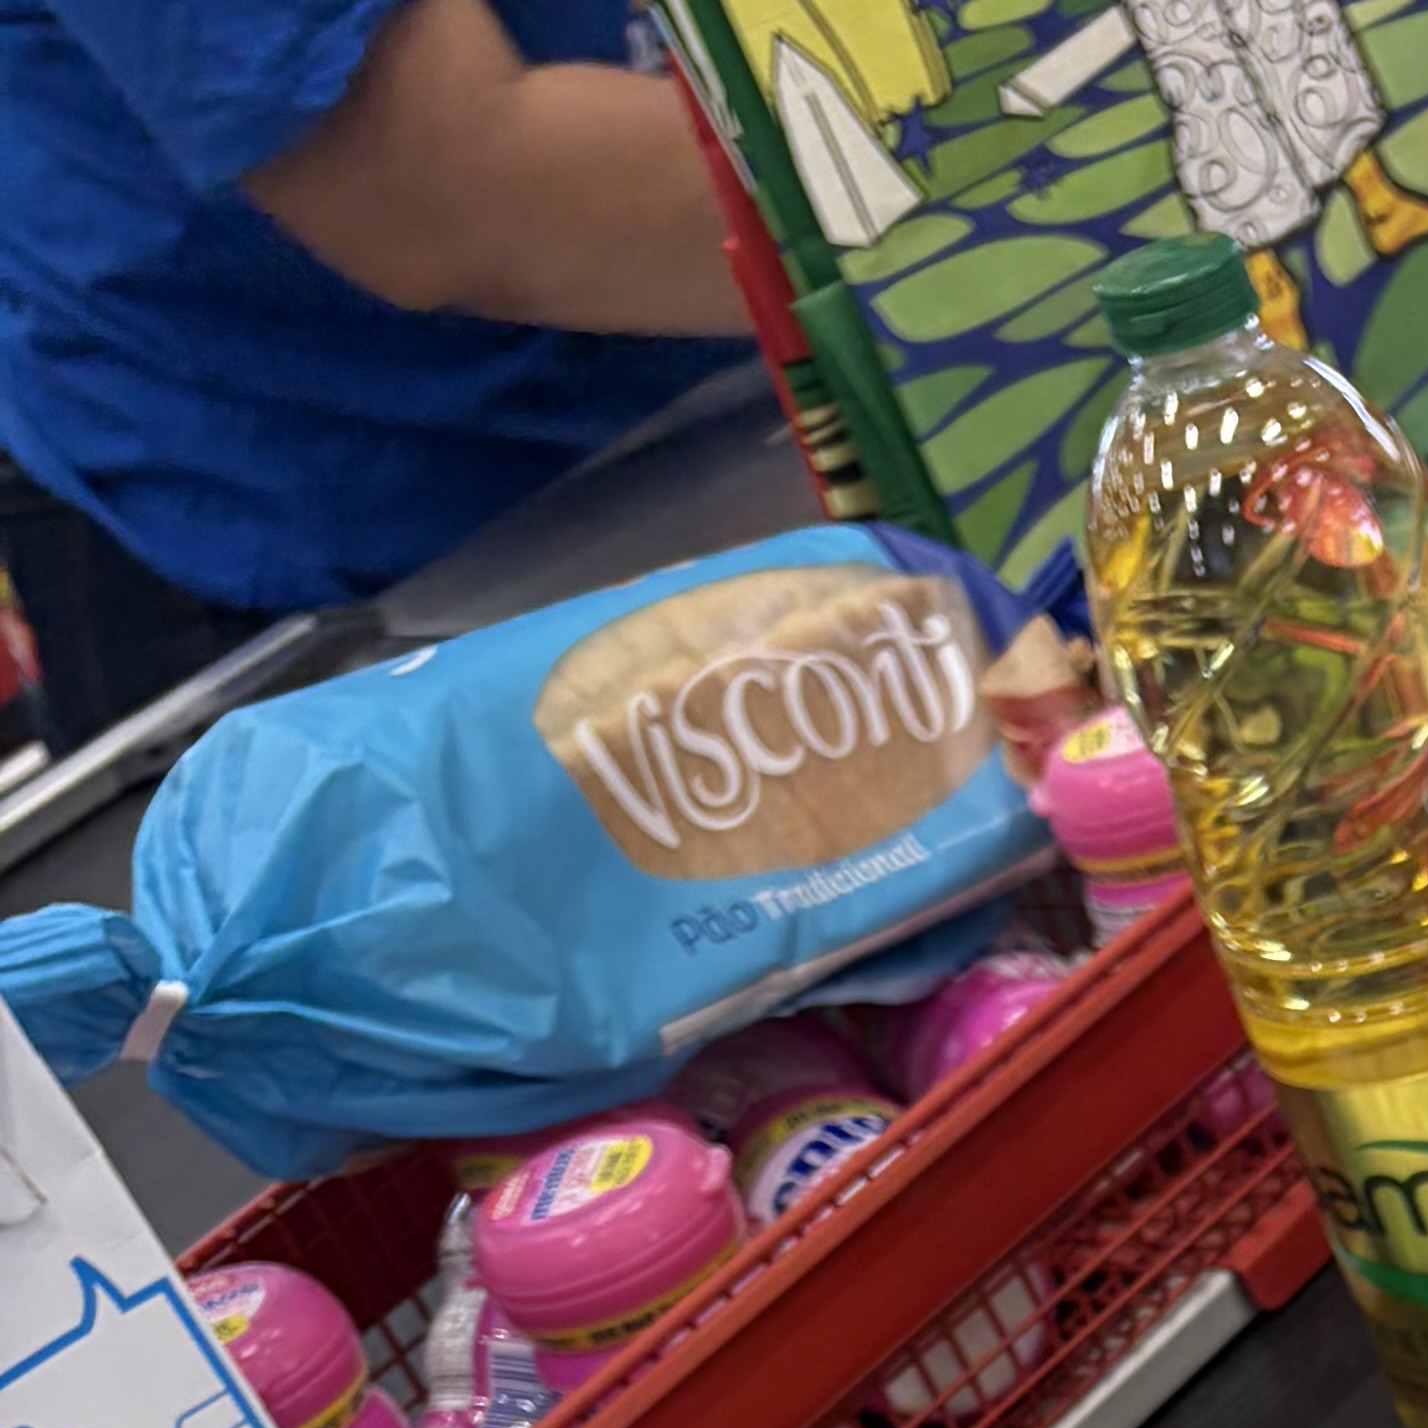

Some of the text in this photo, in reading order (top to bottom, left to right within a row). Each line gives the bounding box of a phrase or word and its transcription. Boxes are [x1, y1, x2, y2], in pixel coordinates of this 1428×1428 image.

[573, 602, 974, 849] Visconti
[668, 833, 932, 957] Pão Tradicional
